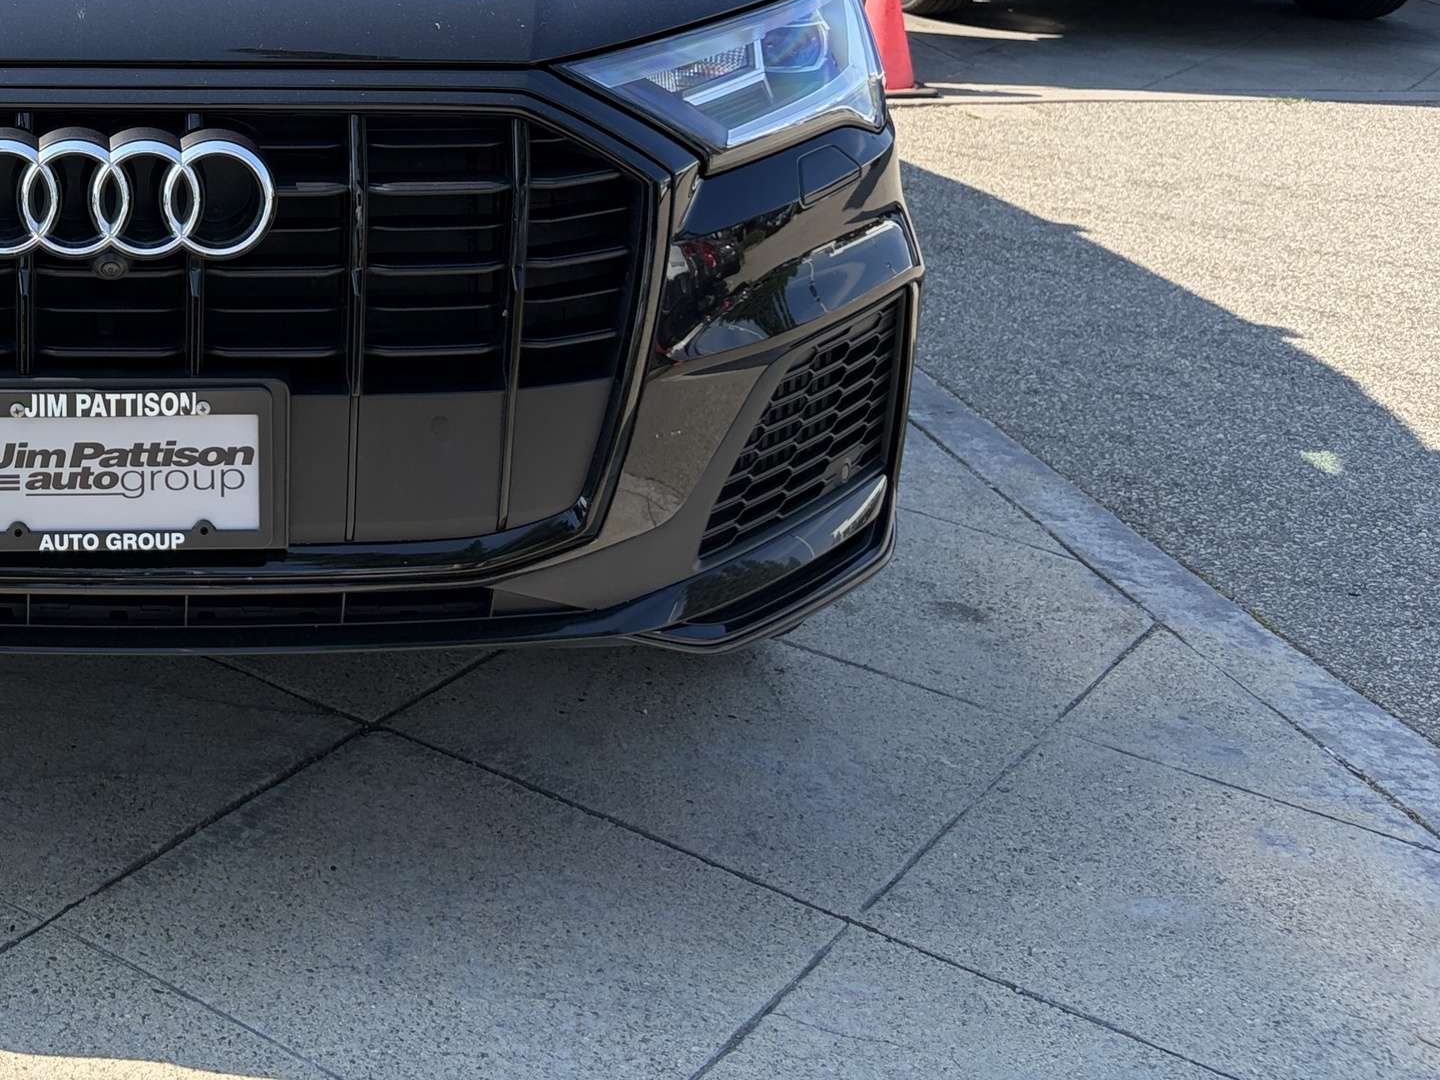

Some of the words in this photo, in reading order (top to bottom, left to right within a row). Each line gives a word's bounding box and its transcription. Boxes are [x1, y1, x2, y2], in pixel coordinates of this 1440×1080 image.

[24, 393, 67, 417] JIM
[75, 392, 197, 417] PATTISON
[69, 441, 255, 469] Pattison
[25, 468, 245, 499] autogroup
[38, 534, 100, 551] AUTO
[105, 533, 185, 551] GROUP
